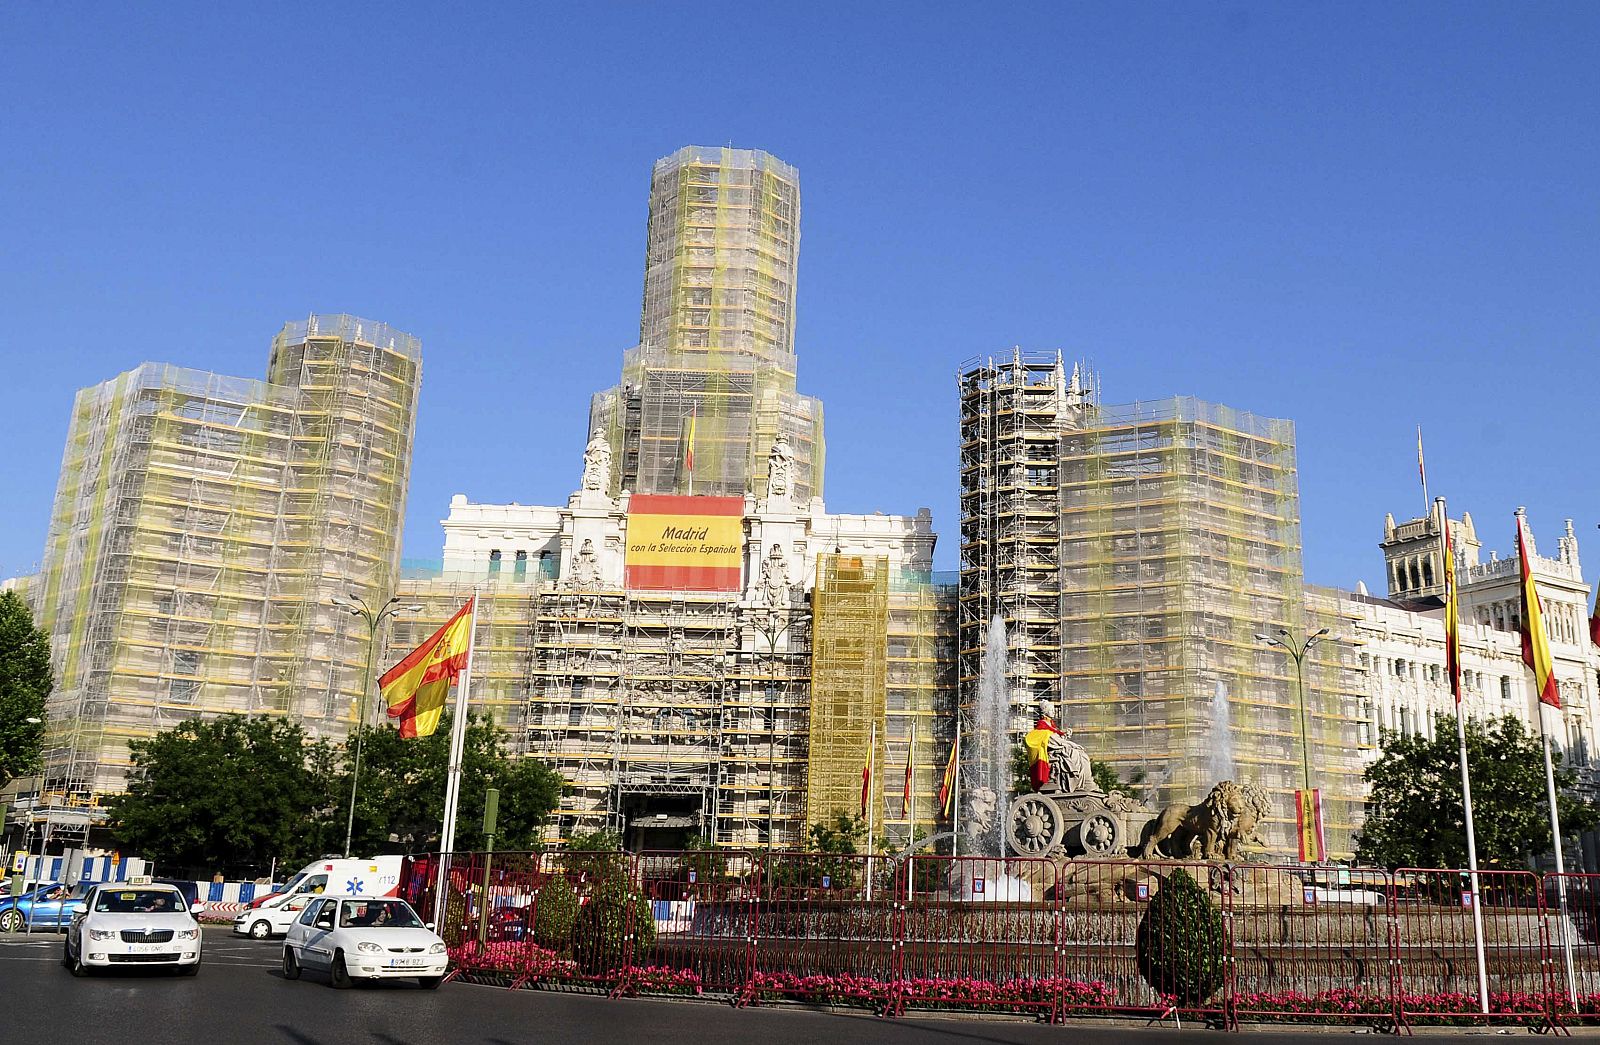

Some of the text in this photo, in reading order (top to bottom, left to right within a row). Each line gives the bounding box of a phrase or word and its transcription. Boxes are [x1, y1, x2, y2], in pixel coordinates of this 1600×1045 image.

[661, 526, 709, 541] Madrid
[630, 543, 737, 555] con la Selección Española
